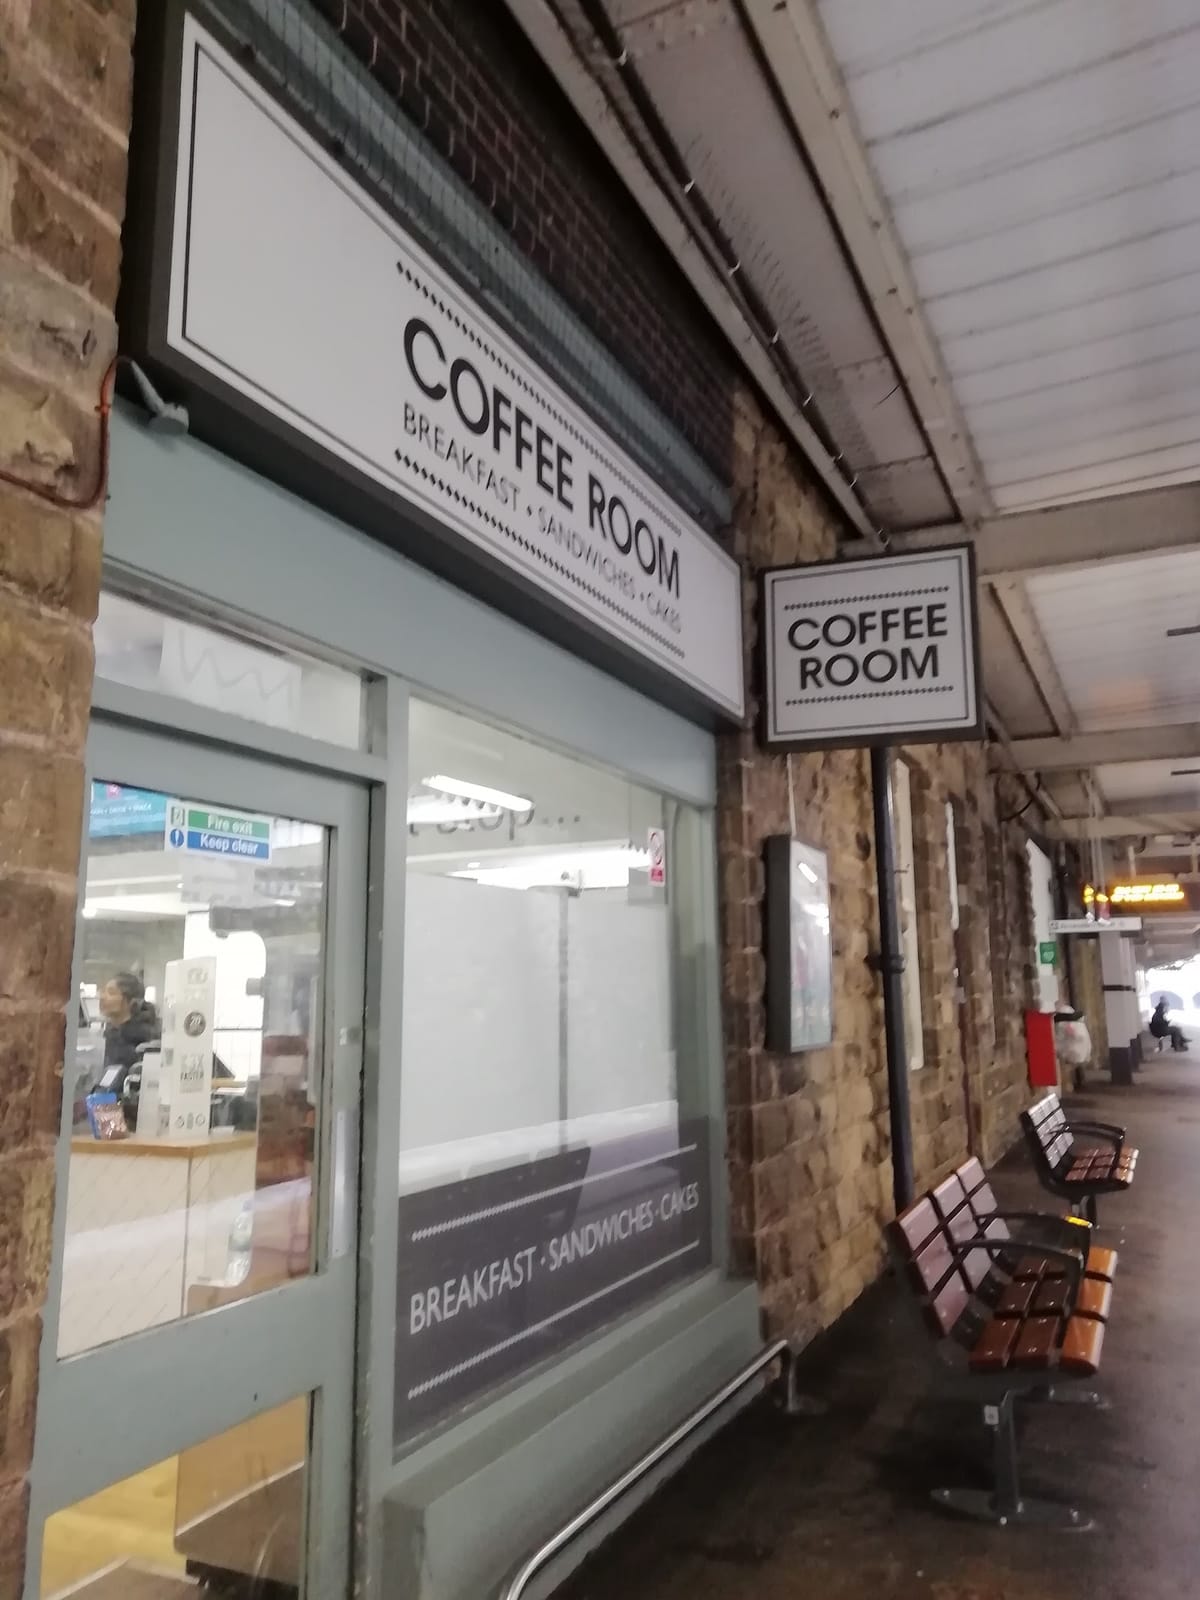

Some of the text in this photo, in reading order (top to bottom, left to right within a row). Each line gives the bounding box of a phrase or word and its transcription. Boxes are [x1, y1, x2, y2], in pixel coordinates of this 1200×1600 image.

[403, 317, 681, 600] COFFEE ROOM
[404, 402, 522, 512] BREAKFAST
[538, 507, 635, 600] SANDWICHES
[788, 602, 948, 651] COFFEE
[799, 644, 939, 690] ROOM
[199, 833, 259, 855] Keep clear
[207, 813, 253, 835] Fire exit
[409, 1181, 700, 1336] BREAKFAST SANDWICHES CAKES
